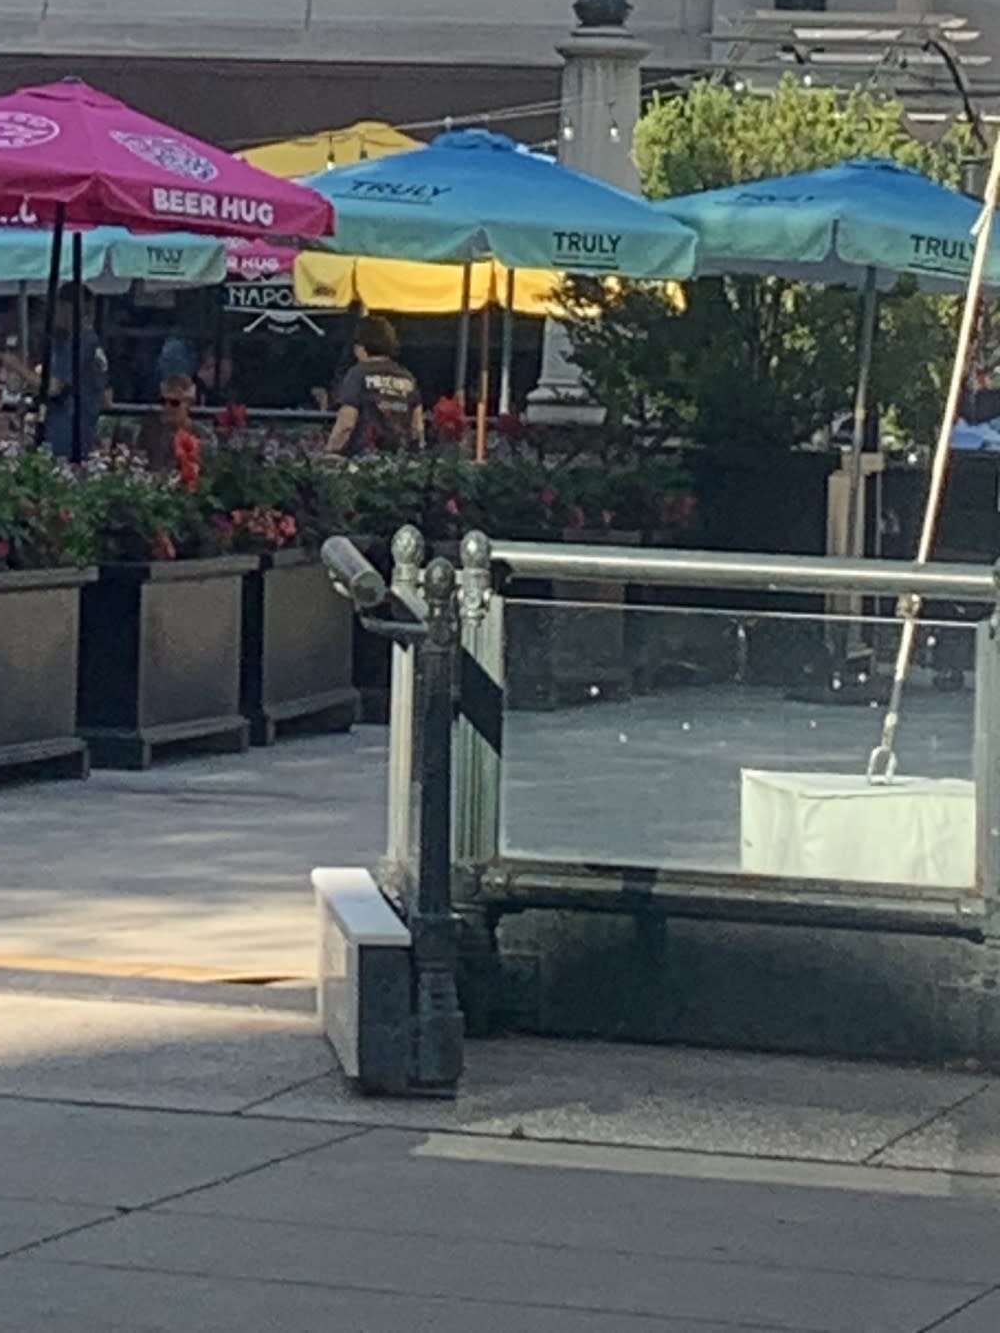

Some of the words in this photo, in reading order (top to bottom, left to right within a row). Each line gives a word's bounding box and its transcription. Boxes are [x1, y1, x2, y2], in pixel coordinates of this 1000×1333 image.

[351, 179, 451, 197] TRULY
[152, 187, 217, 217] BEER
[221, 196, 274, 226] HUG
[553, 231, 621, 254] TRULY
[228, 286, 299, 307] NAPO
